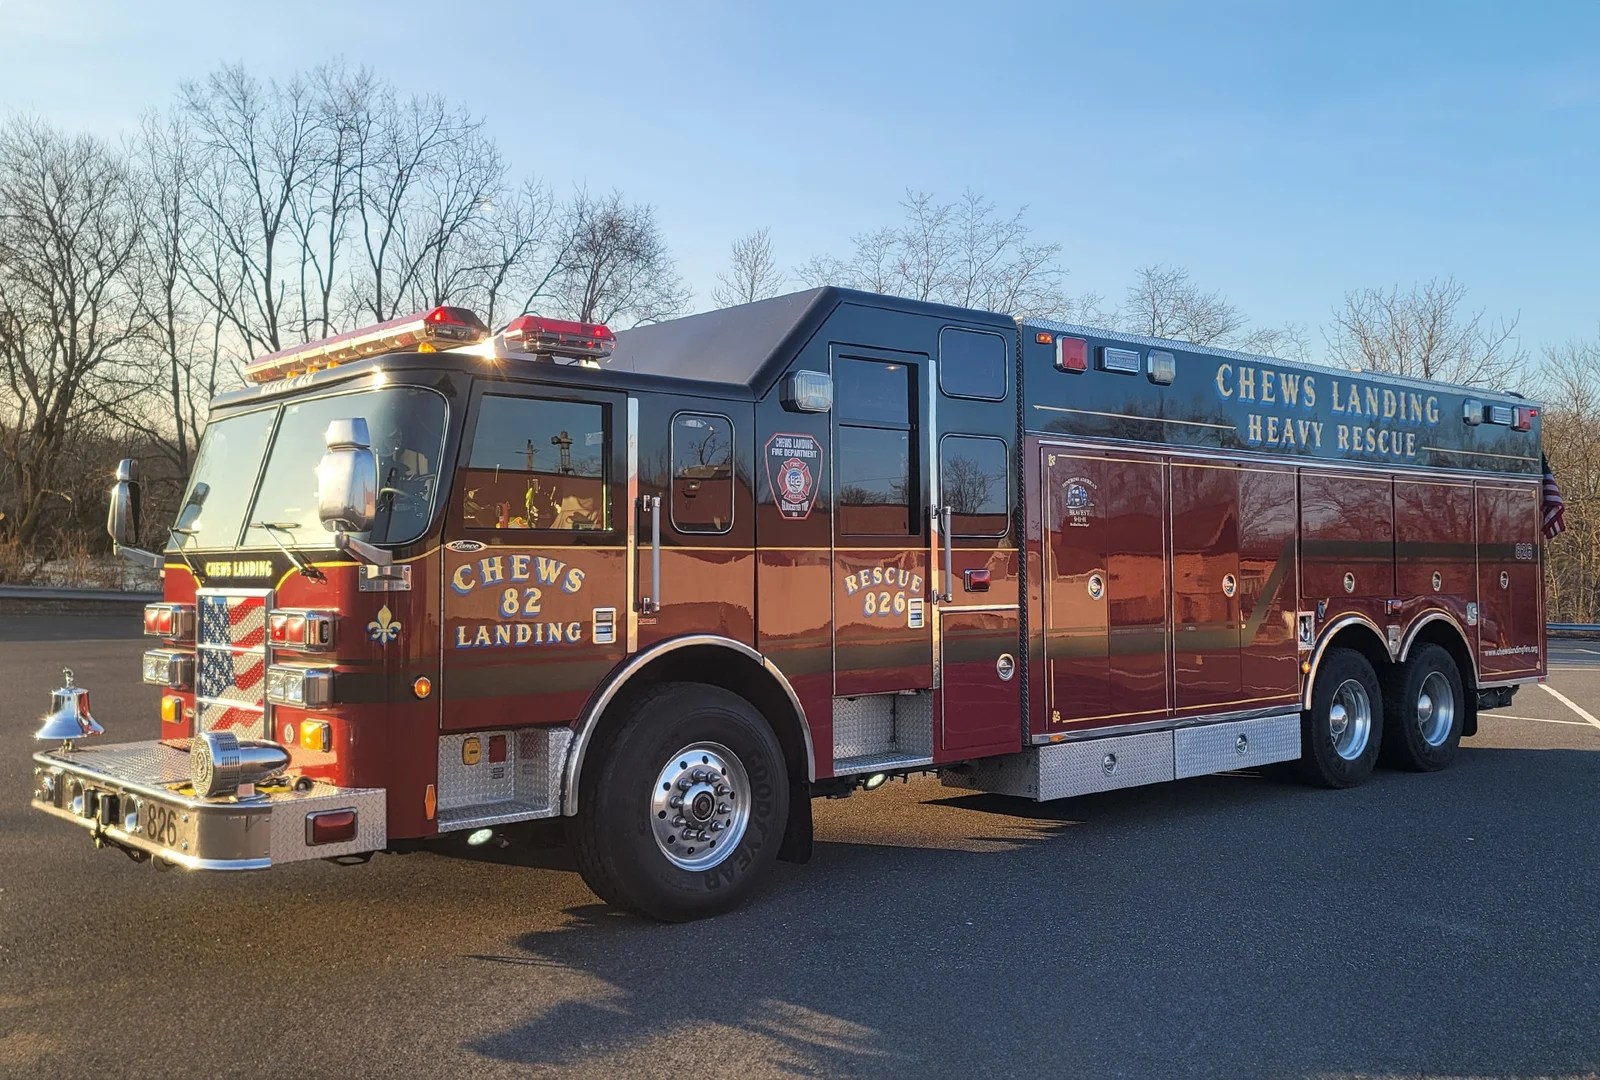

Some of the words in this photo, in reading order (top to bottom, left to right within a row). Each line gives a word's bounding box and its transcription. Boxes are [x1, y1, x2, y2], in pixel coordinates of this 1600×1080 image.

[1214, 363, 1316, 409] CHEWS
[1331, 381, 1440, 427] LANDING
[775, 437, 792, 448] CHEWS
[793, 438, 814, 450] LANDING
[1247, 414, 1324, 449] HEAVY
[1337, 424, 1416, 458] RESCUE
[771, 448, 783, 456] FIRE
[784, 449, 817, 458] DEPARTMENT
[1515, 543, 1533, 560] 826
[204, 561, 232, 577] CHEWS
[233, 560, 273, 577] LANDING
[452, 554, 586, 595] CHEWS
[845, 566, 922, 596] RESCUE
[499, 587, 542, 618] 82
[864, 591, 906, 618] 826
[456, 621, 582, 649] LANDING
[147, 803, 177, 847] 826
